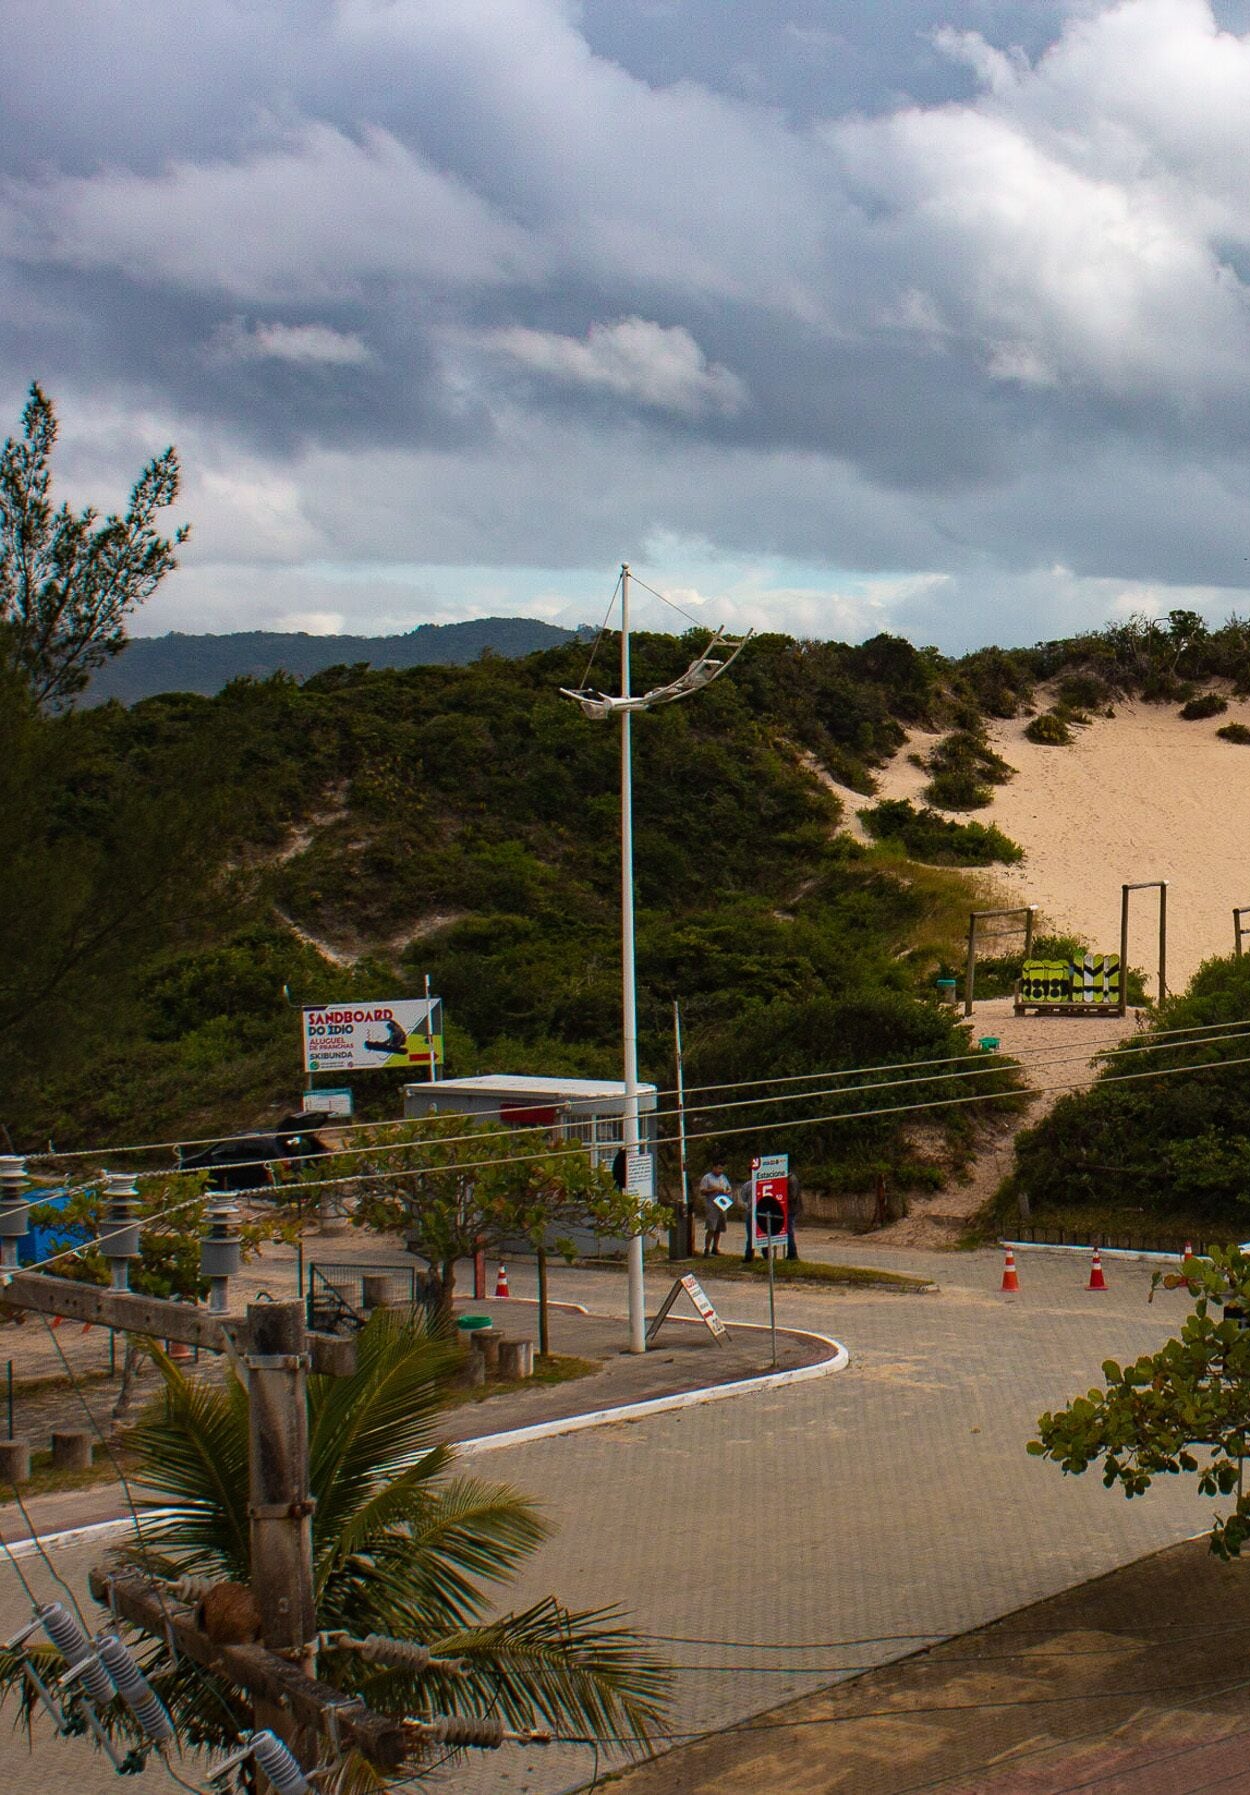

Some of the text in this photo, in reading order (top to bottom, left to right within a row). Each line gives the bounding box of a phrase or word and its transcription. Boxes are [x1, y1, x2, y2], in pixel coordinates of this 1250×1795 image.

[308, 1009, 393, 1025] SANDBOARD
[308, 1025, 325, 1036] DO
[310, 1037, 346, 1045] ALUGUEL
[310, 1051, 353, 1060] SKIBUNDA
